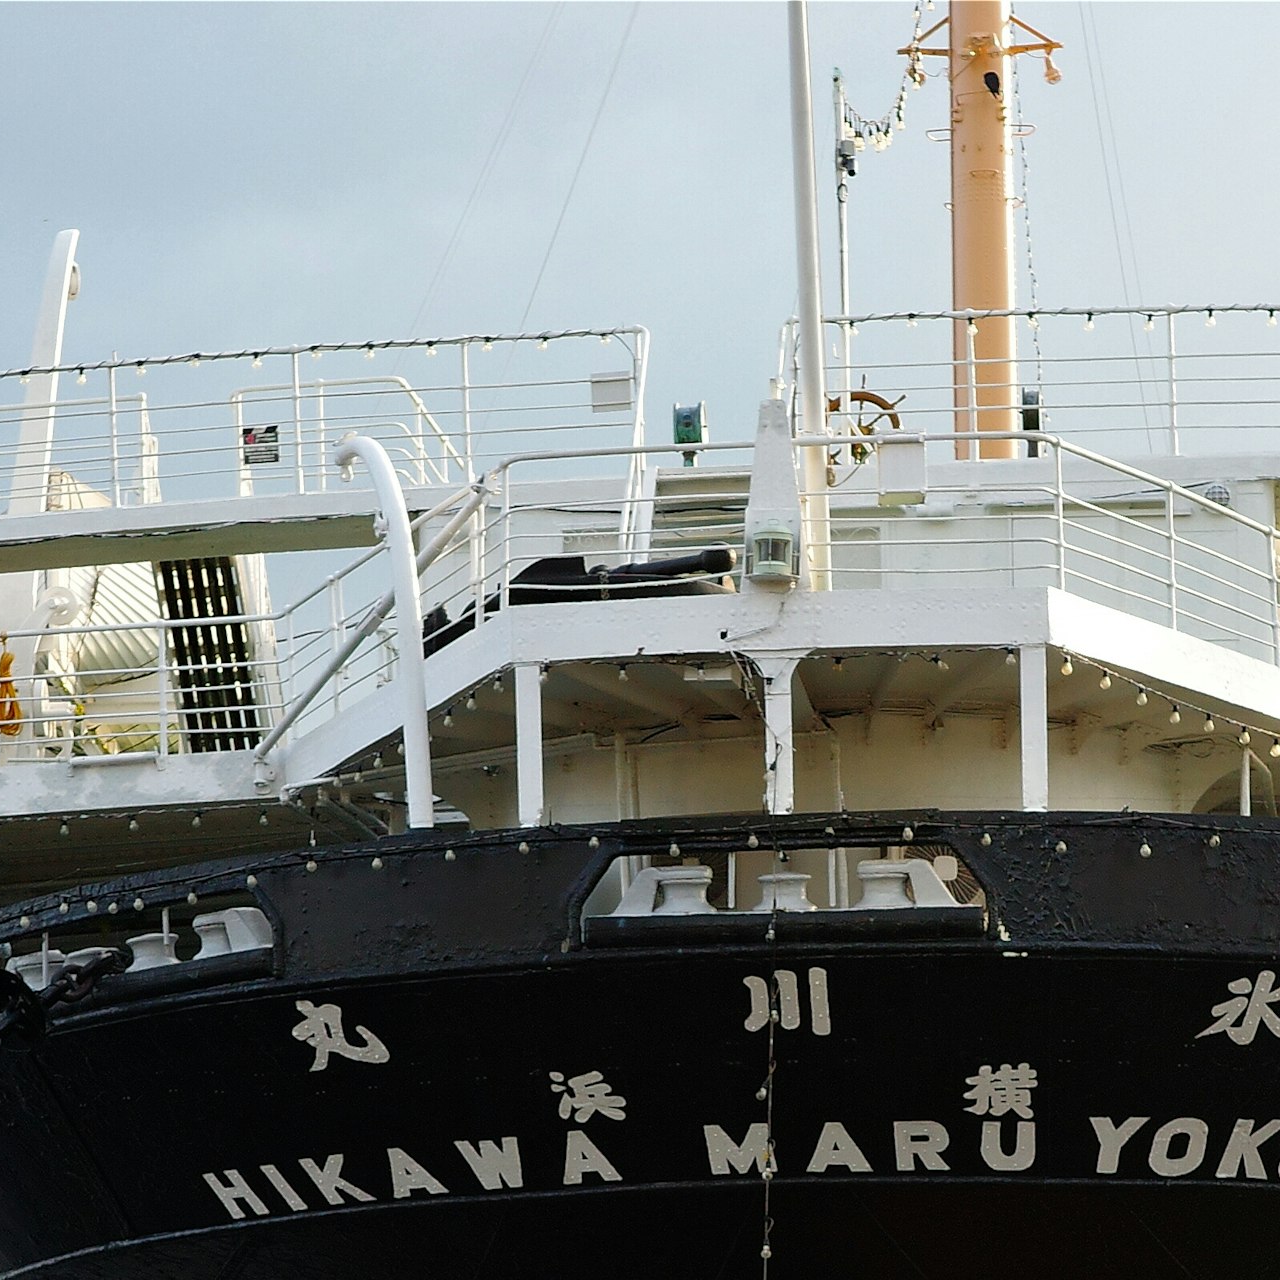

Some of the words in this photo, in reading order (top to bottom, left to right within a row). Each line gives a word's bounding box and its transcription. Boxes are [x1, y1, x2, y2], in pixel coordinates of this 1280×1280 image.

[292, 1000, 390, 1072] 丸
[743, 966, 831, 1036] 川
[549, 1071, 626, 1123] 浜
[203, 1129, 623, 1220] HIKAWA
[703, 1120, 1037, 1176] MARU
